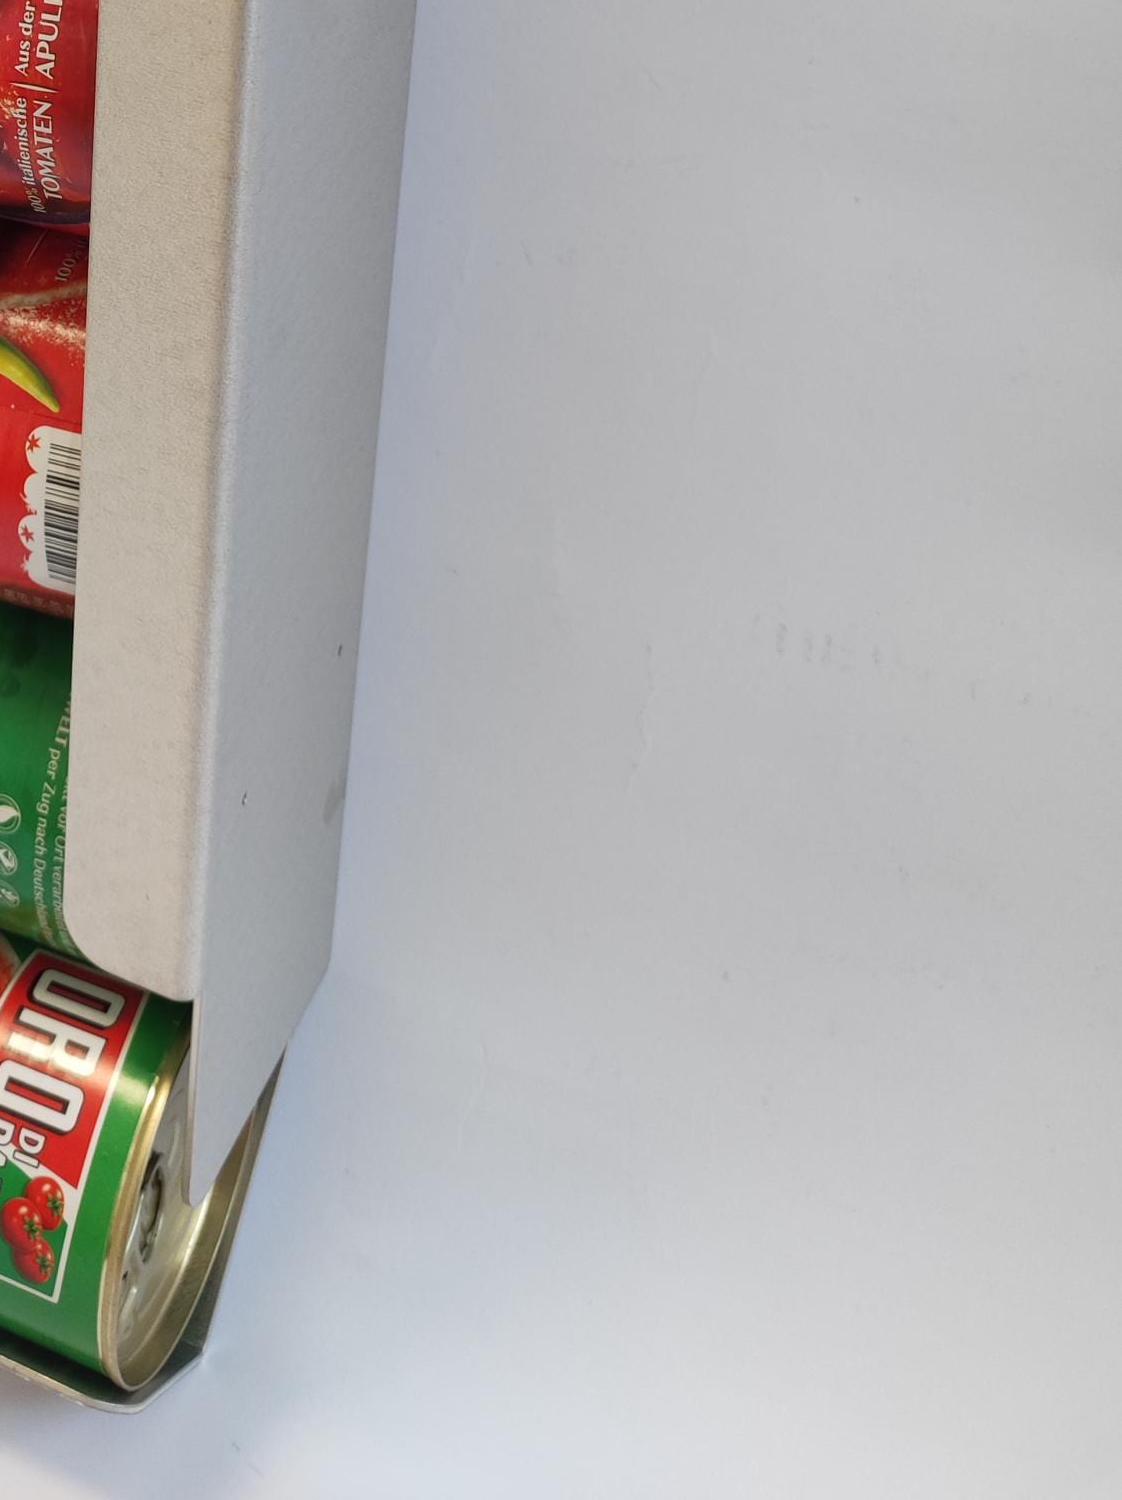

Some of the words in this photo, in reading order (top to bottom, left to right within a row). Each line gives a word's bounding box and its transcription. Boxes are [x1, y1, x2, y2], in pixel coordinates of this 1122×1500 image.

[17, 0, 37, 37] der
[13, 38, 32, 77] Aus
[10, 97, 37, 186] italienische
[32, 100, 64, 200] TOMATEN
[24, 187, 48, 213] 100%
[45, 747, 62, 780] per
[35, 781, 56, 815] Zug
[33, 817, 50, 855] nach
[12, 1126, 47, 1169] DI
